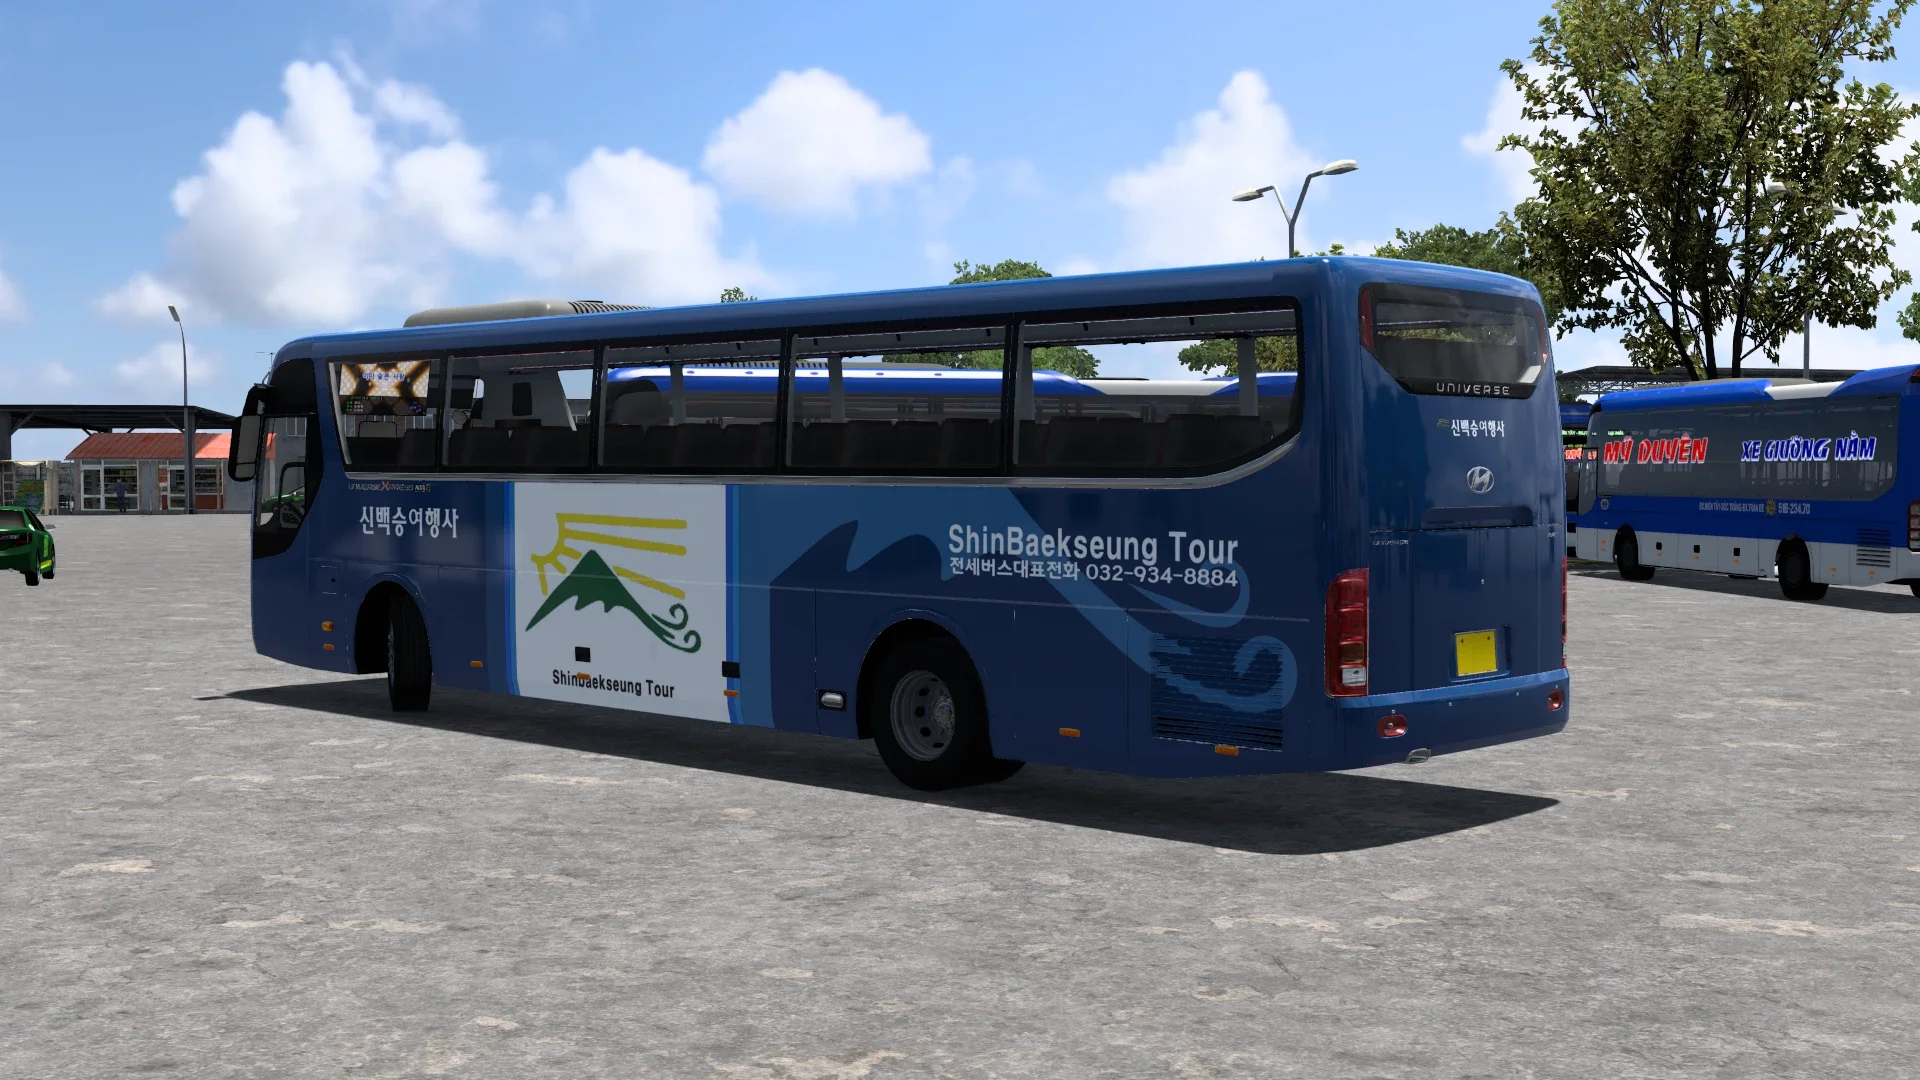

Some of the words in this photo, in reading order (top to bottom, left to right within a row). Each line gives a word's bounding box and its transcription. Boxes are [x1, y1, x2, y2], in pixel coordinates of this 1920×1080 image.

[1436, 382, 1510, 396] UNIVERSE
[1451, 419, 1505, 438] 신백승여행사
[1603, 435, 1634, 465] MỸ
[1637, 432, 1709, 465] DUYÊN
[1740, 439, 1762, 462] XE
[359, 506, 459, 539] 신백승여행사
[949, 524, 1158, 566] ShinBaekseung
[1168, 531, 1239, 565] Tour
[949, 557, 1081, 582] 전세버스대표전화
[1086, 563, 1239, 588] 032-934-8884
[646, 679, 675, 699] Tour
